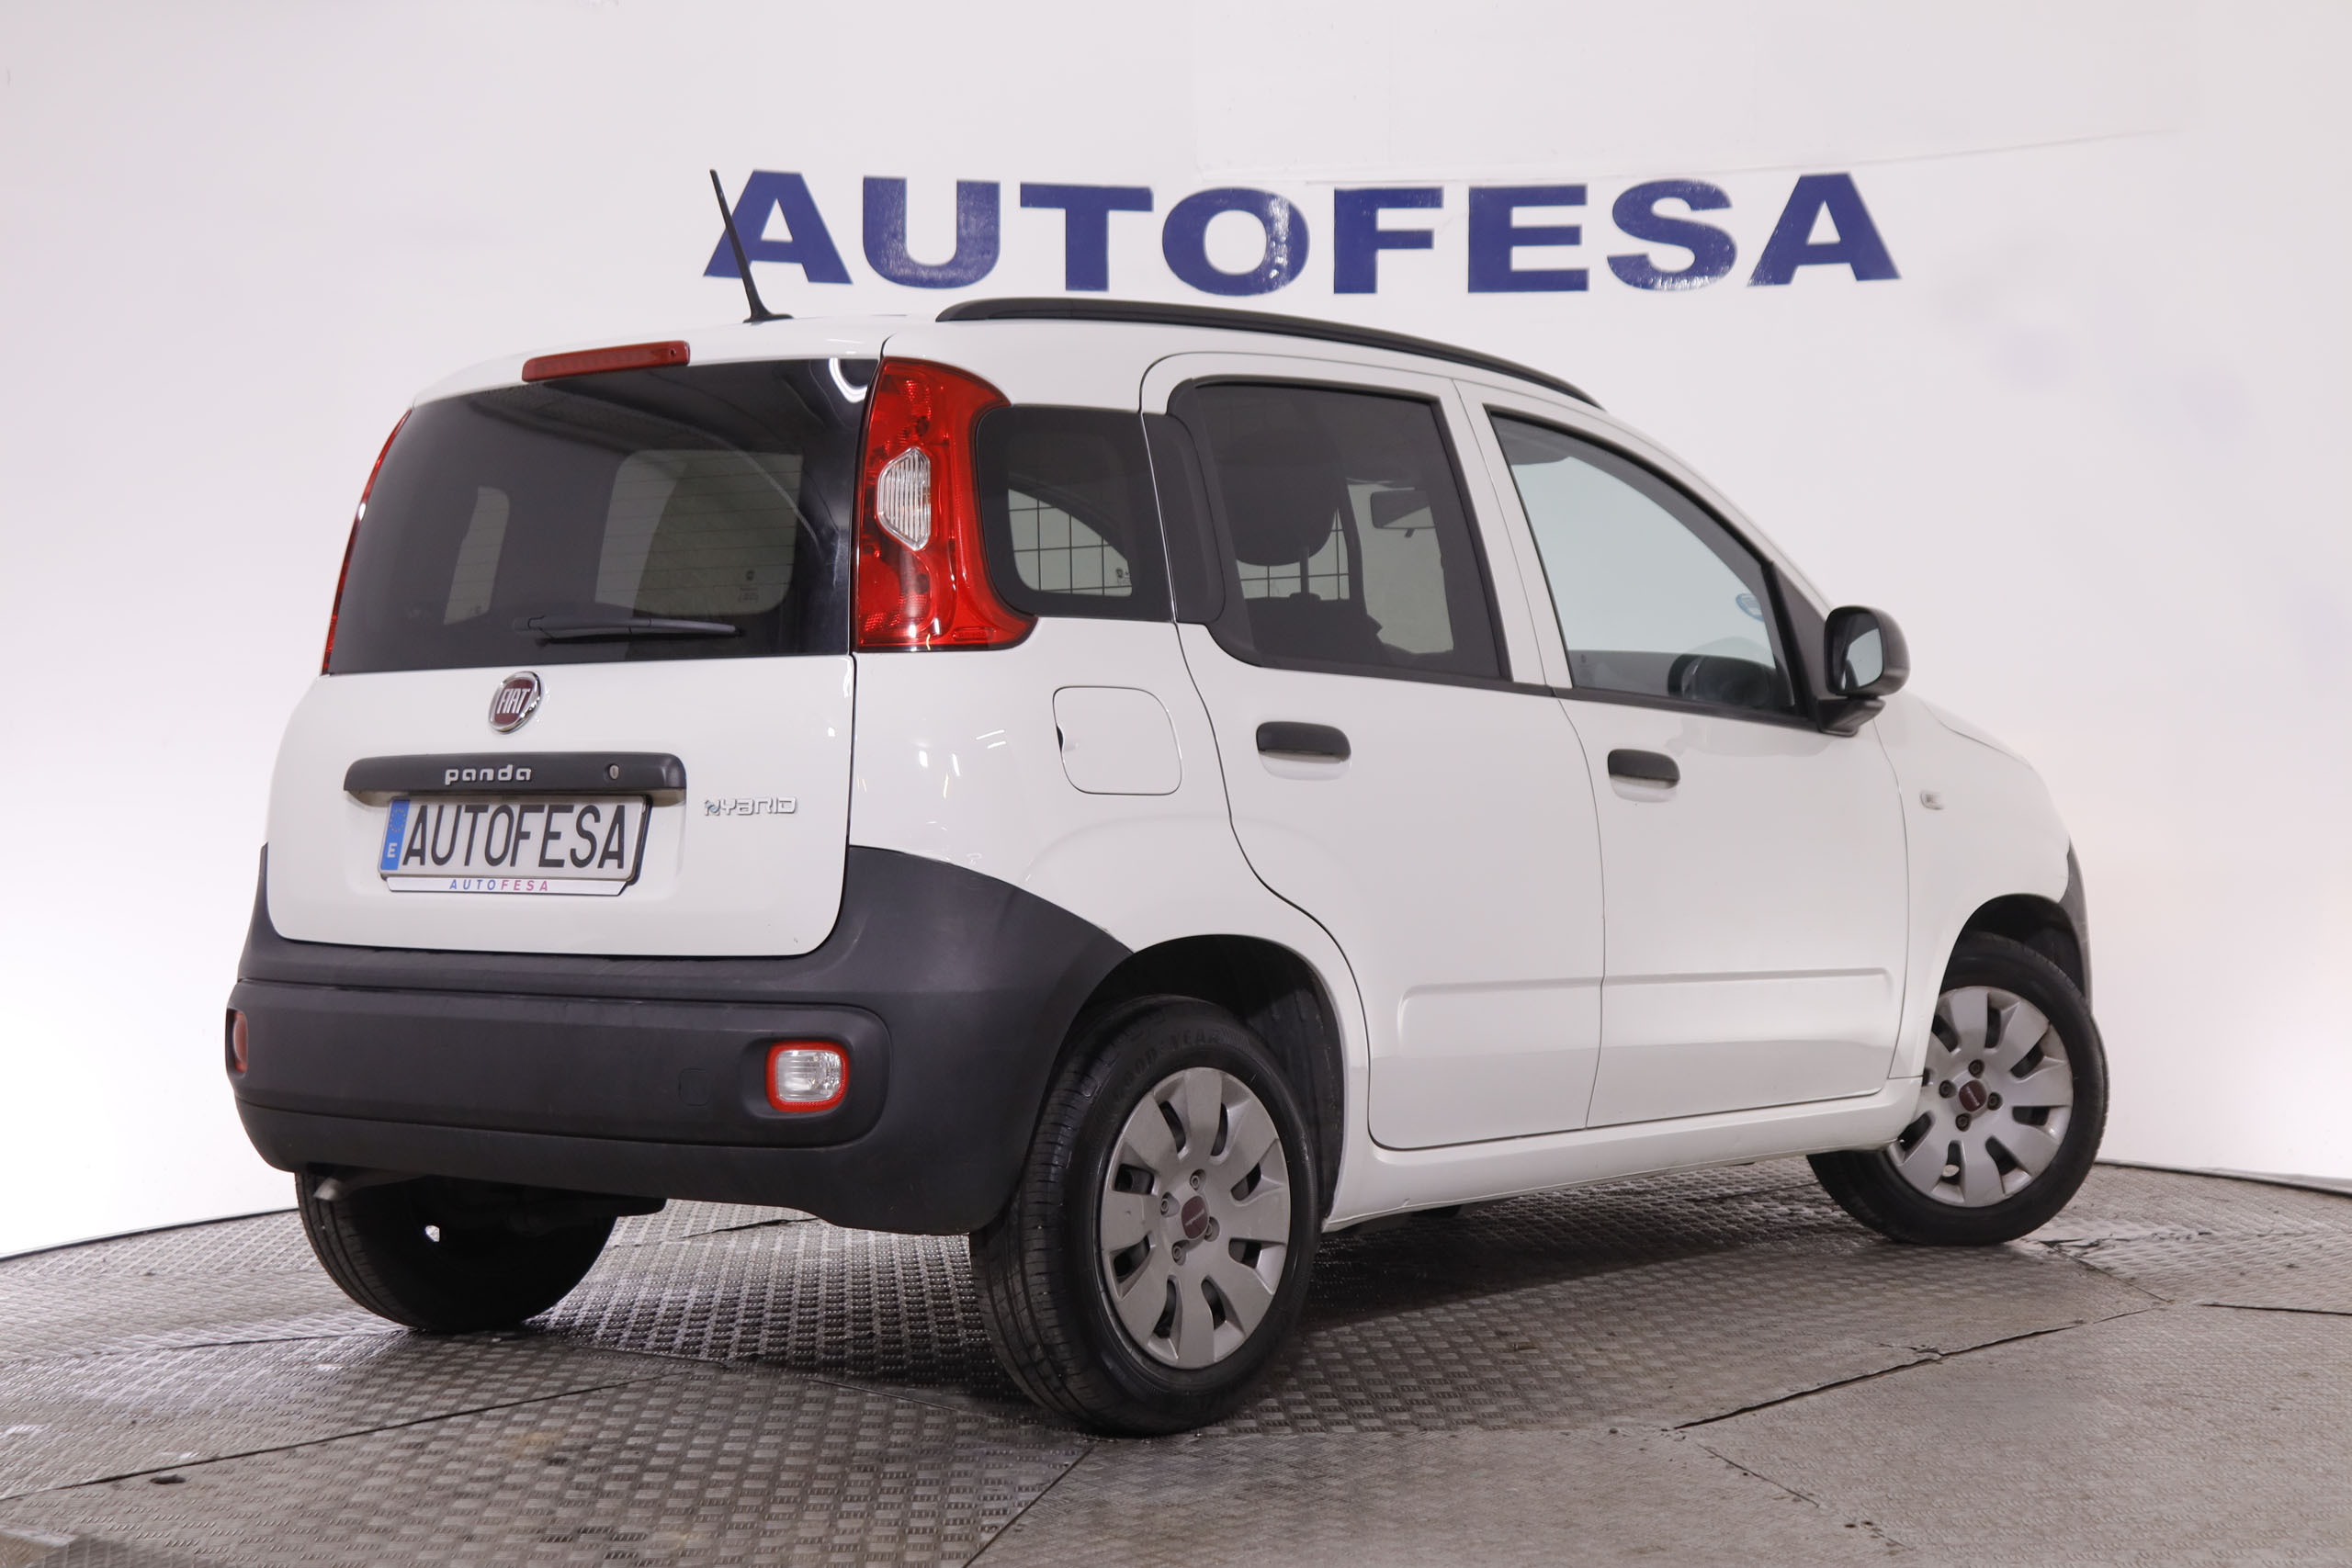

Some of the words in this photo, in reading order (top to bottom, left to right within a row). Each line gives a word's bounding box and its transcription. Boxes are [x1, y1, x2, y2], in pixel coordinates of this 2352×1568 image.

[704, 169, 1902, 295] AUTOFESA
[496, 687, 531, 715] FIAT
[444, 764, 532, 785] panda
[402, 804, 626, 870] AUTOFESA
[386, 842, 398, 858] E
[449, 879, 548, 892] AUTOFESA
